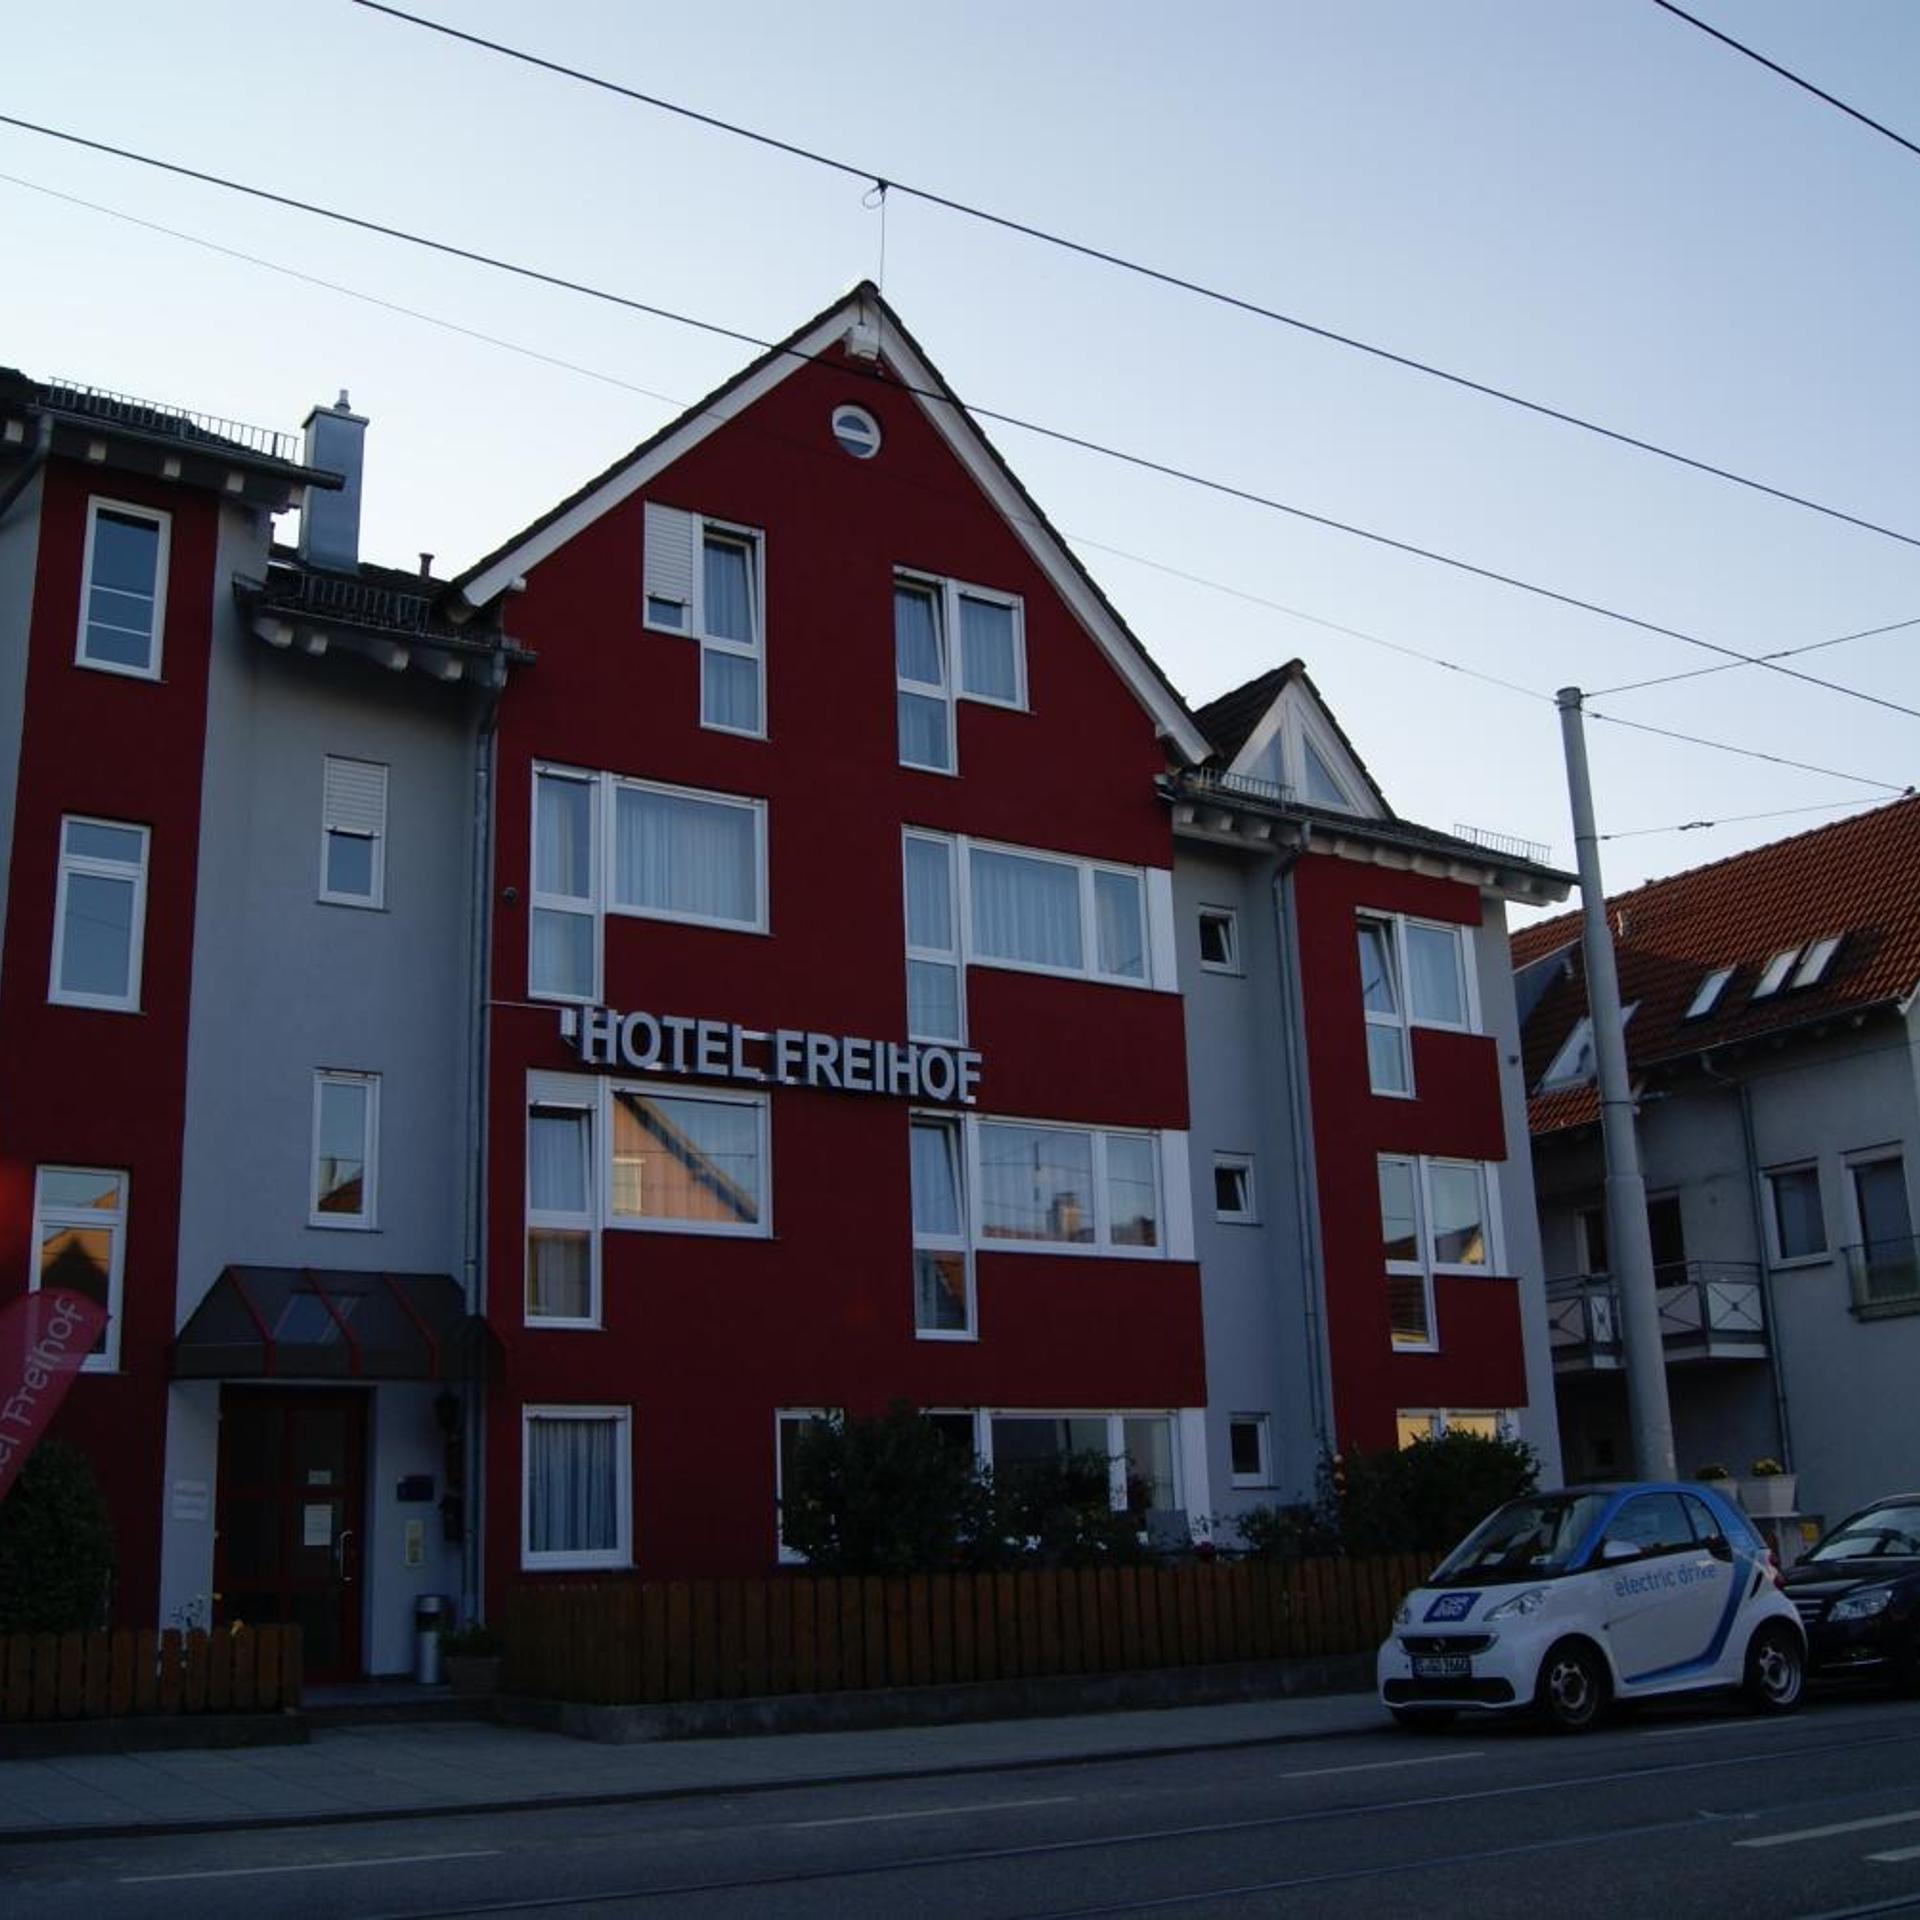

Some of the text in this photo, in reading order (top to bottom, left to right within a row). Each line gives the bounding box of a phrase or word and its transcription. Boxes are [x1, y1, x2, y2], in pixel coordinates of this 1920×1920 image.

[581, 1005, 983, 1103] HOTEL FREIHOF
[1, 1294, 84, 1427] Freihof
[1614, 1563, 1716, 1597] electric drive
